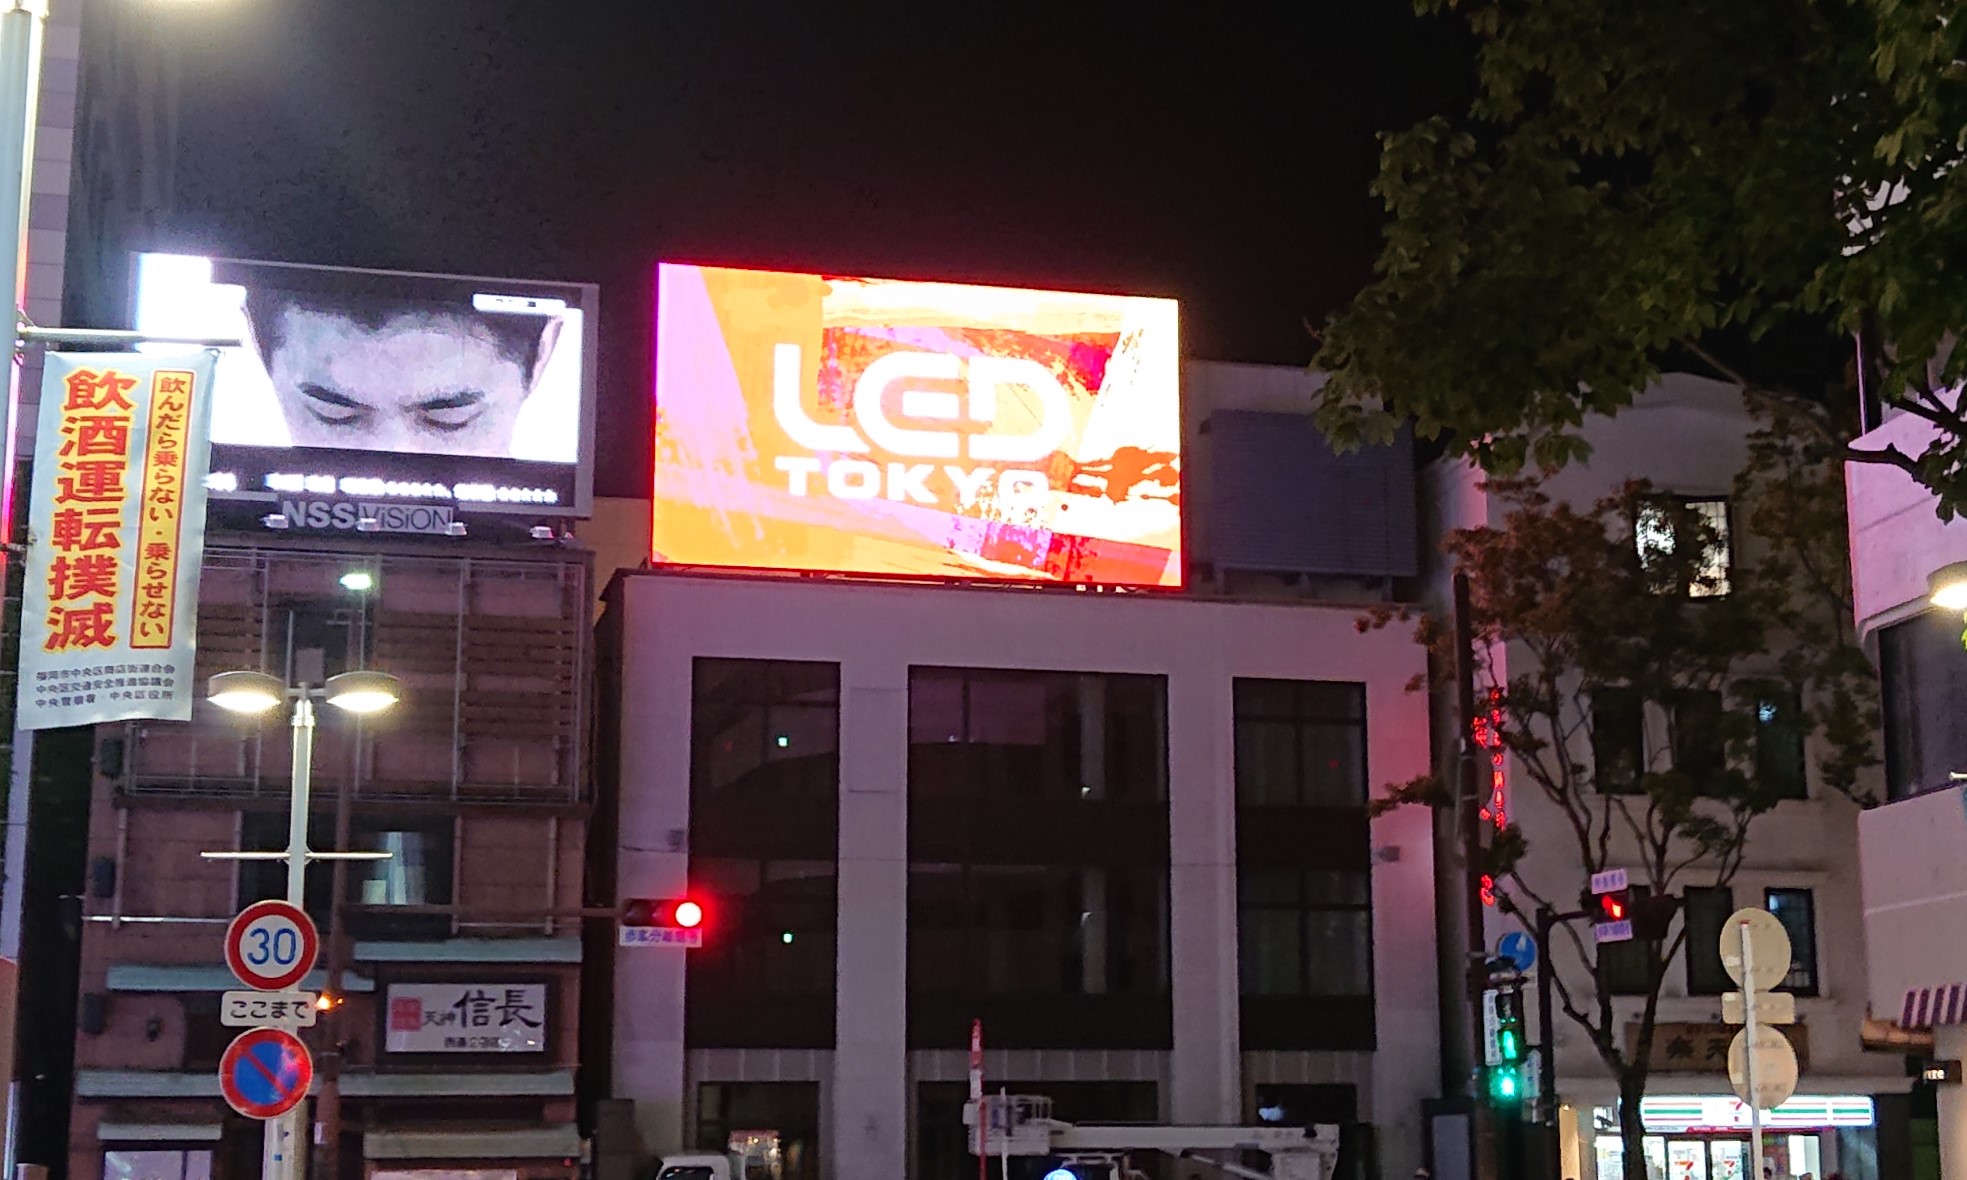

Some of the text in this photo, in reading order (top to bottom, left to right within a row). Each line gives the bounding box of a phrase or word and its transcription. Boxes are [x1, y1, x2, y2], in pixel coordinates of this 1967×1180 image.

[773, 342, 1071, 462] LED
[773, 455, 1050, 505] TOKYO
[44, 369, 136, 650] 飲酒運転撲滅
[140, 376, 186, 638] 飲んだら乗らない・乗らせない
[281, 500, 353, 530] NSS
[247, 927, 297, 965] 30
[230, 1000, 309, 1020] ここまで
[453, 989, 543, 1029] 信長
